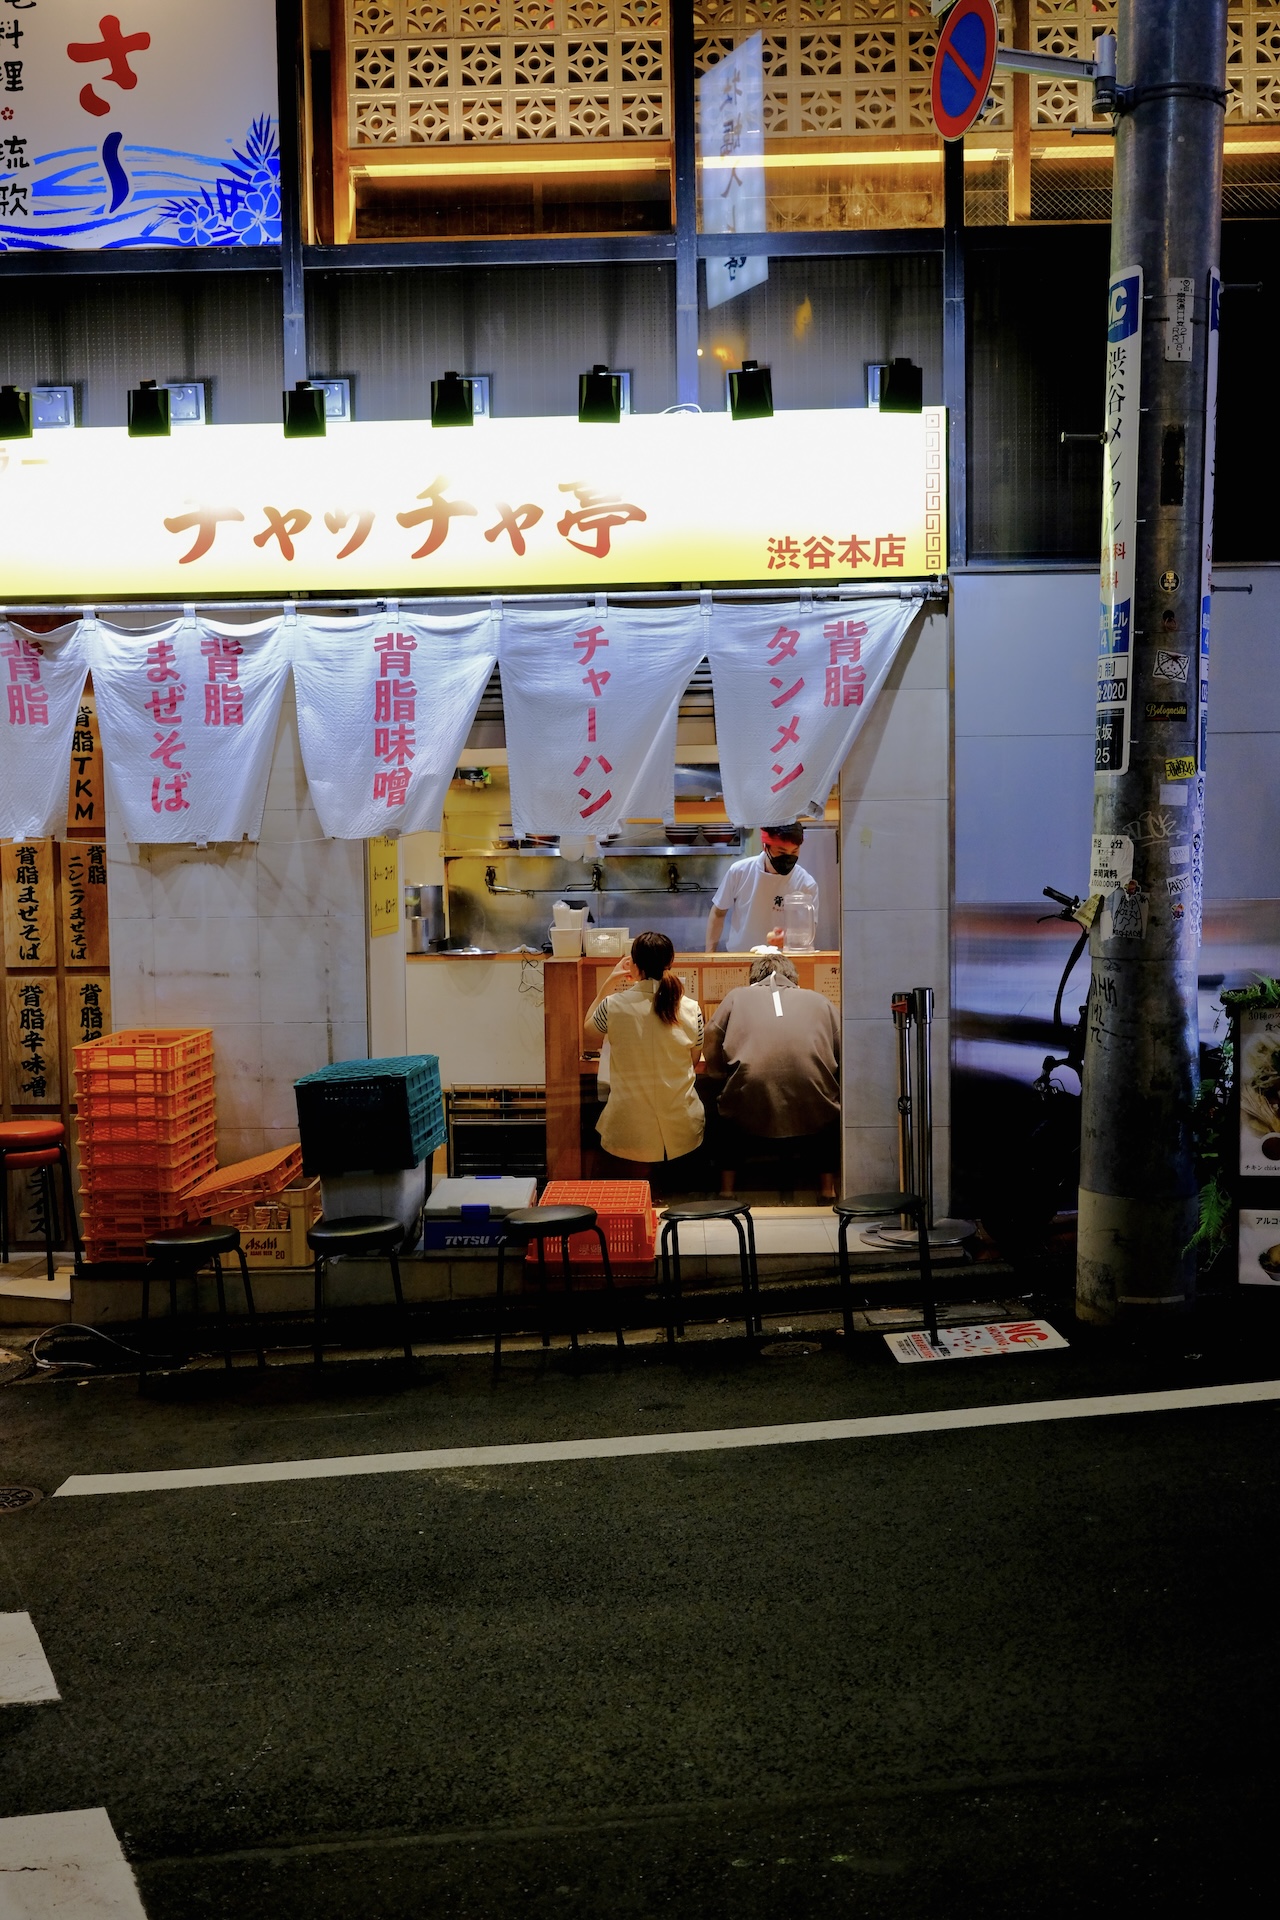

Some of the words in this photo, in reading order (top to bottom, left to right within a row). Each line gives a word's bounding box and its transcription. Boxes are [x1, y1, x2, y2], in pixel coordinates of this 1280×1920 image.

[163, 475, 647, 564] チャッチャ亭
[767, 534, 906, 570] 渋谷本店
[1, 639, 49, 726] 背脂
[200, 637, 245, 726] 背脂
[823, 620, 868, 707] 背脂
[145, 640, 191, 814] まぜそば
[373, 632, 418, 808] 背脂味噌
[573, 625, 613, 819] チャーハン
[767, 626, 805, 794] タンメン
[15, 847, 39, 960] 背脂まぜそば
[87, 845, 106, 885] 背脂
[19, 985, 47, 1098] 背脂辛味噌
[245, 1237, 278, 1250] Asahi
[275, 1250, 285, 1260] 20
